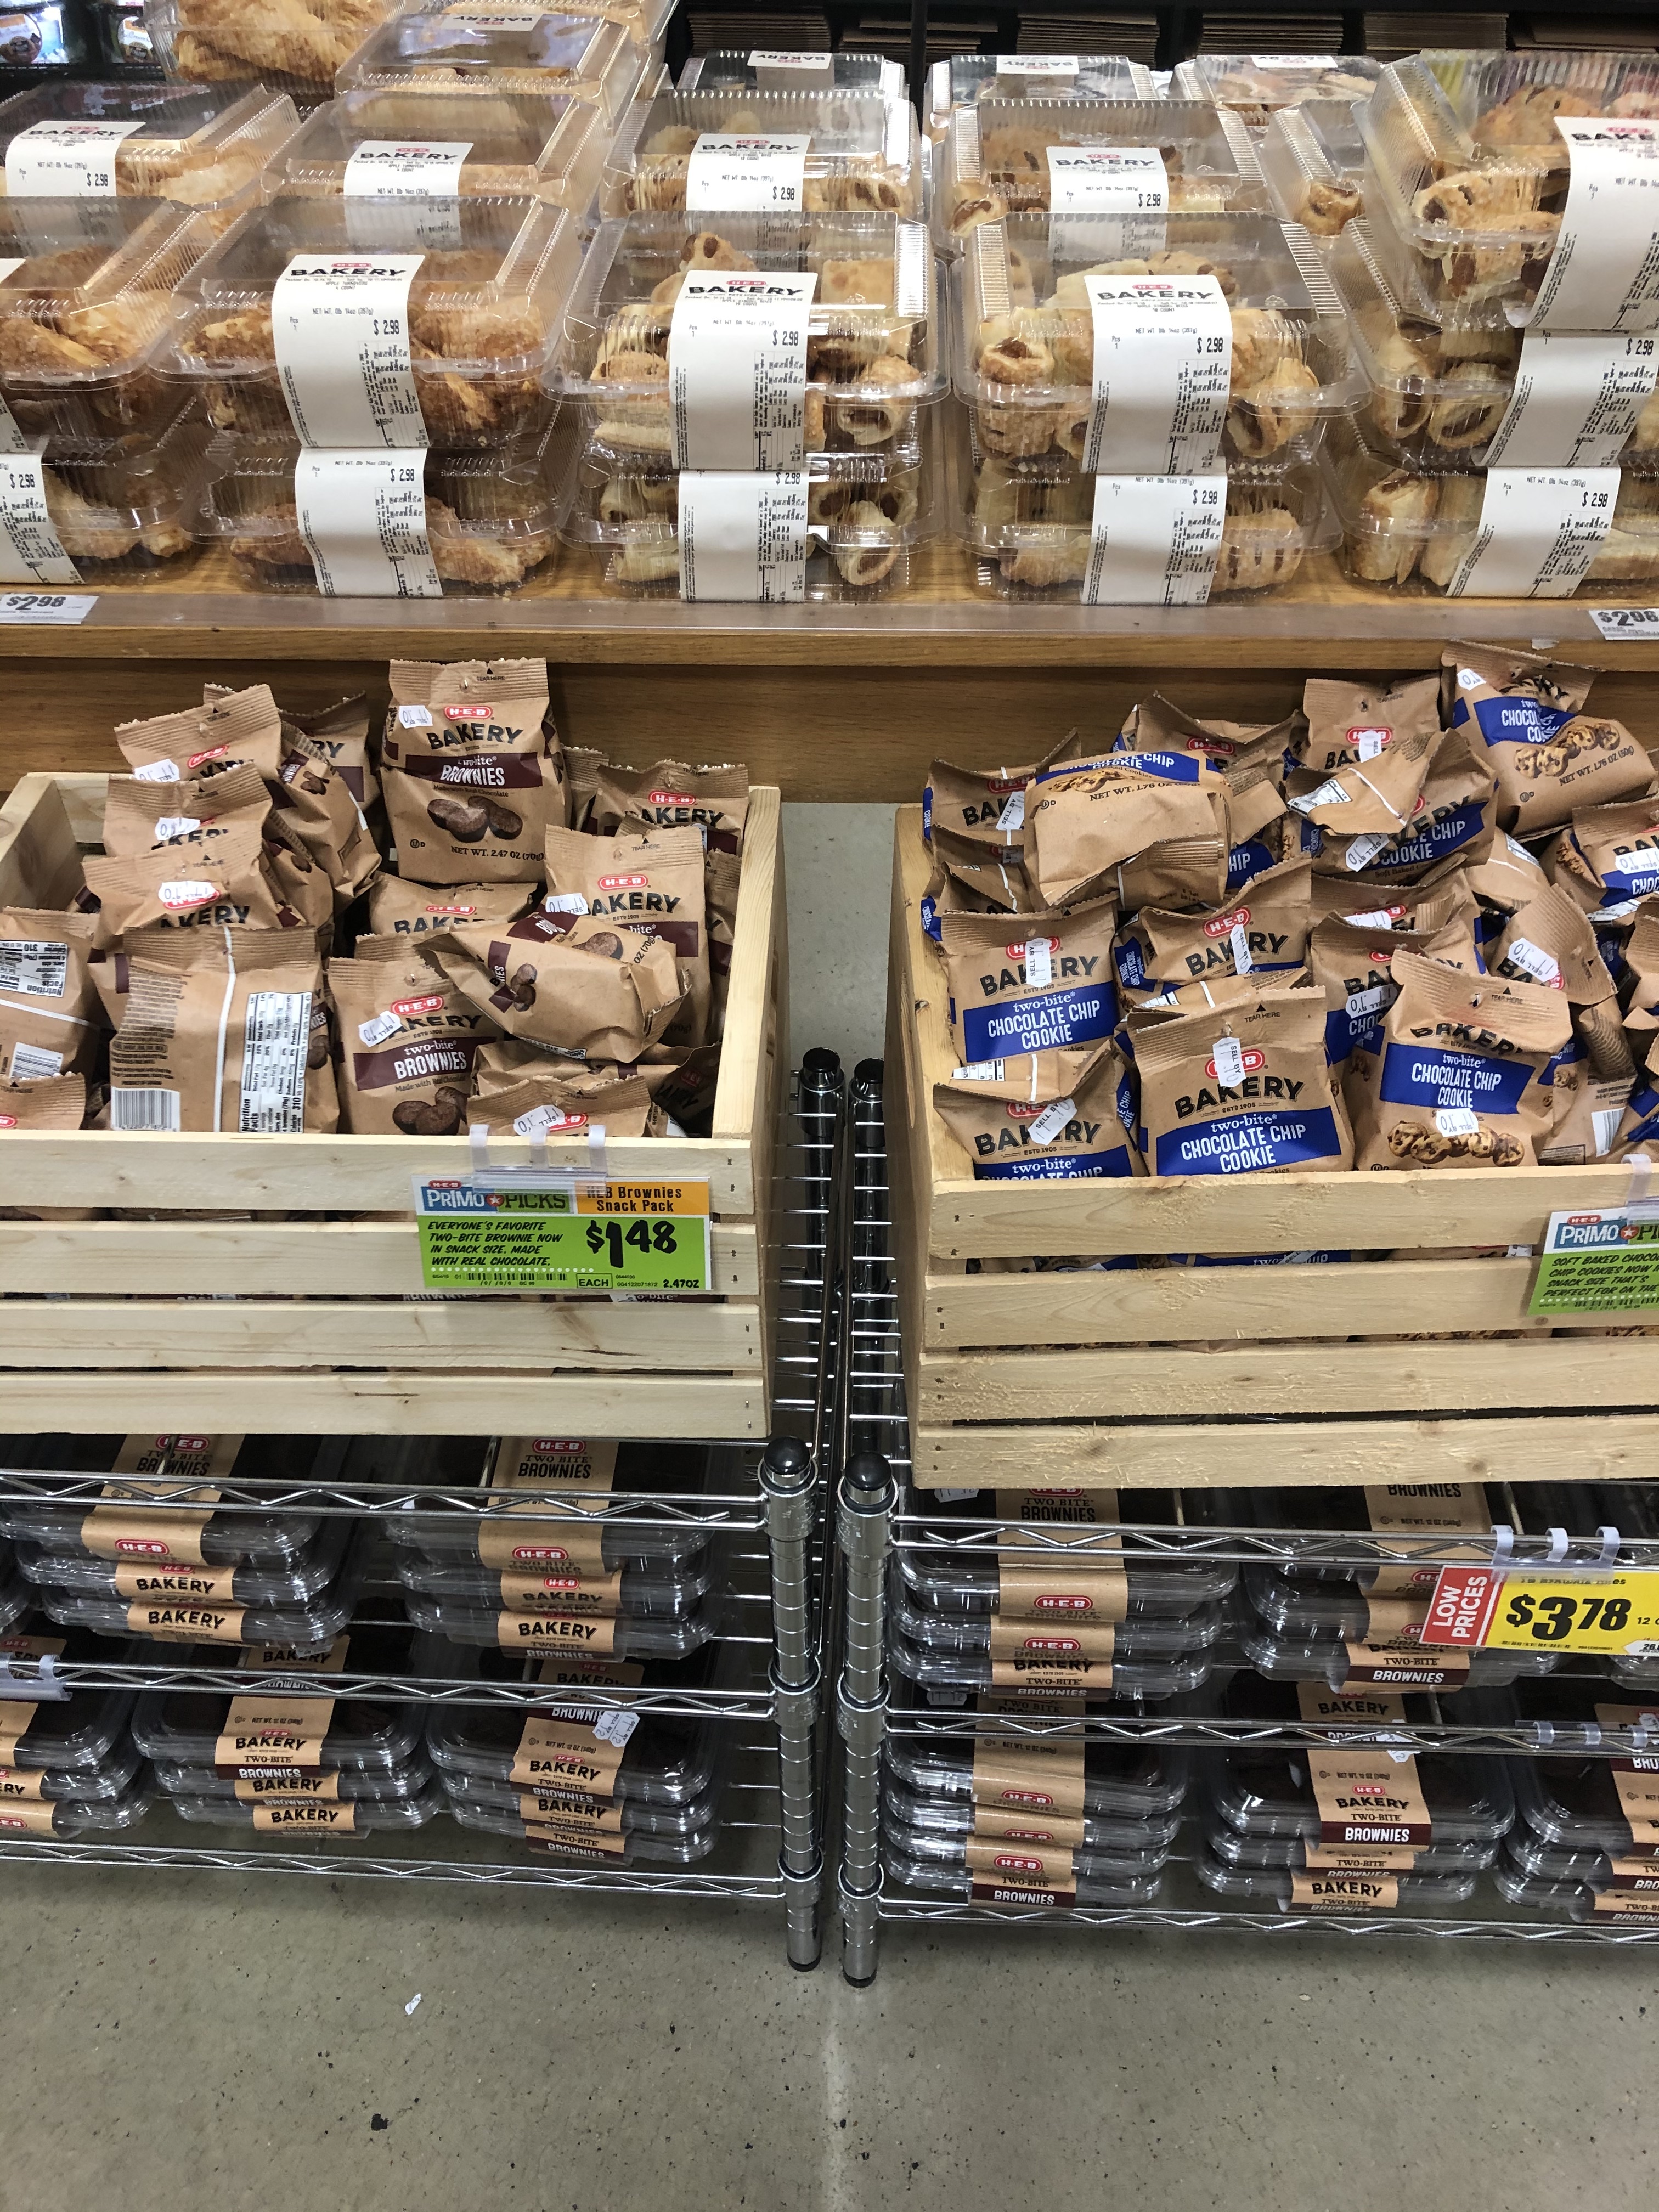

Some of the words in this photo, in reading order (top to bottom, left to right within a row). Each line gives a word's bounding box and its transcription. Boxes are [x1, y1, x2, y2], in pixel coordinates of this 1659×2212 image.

[95, 174, 109, 187] 2.98
[772, 186, 777, 200] $
[781, 187, 794, 200] 2.98
[1138, 194, 1143, 207] $
[1147, 194, 1161, 206] 2.98
[291, 268, 407, 276] BAKERY
[689, 286, 804, 296] BAKERY
[1097, 291, 1214, 300] BAKERY
[374, 319, 379, 336] $
[383, 320, 399, 335] 2.98
[772, 330, 777, 346] $
[782, 331, 799, 346] 2.98
[1197, 337, 1202, 354] $
[1207, 337, 1223, 353] 2.98
[1626, 338, 1632, 356] $
[1635, 339, 1654, 356] 2.98
[19, 473, 35, 488] 2.98
[390, 468, 395, 482] $
[399, 469, 415, 481] 2.98
[776, 472, 781, 485] $
[785, 472, 800, 484] 2.98
[1193, 489, 1198, 505] $
[1201, 490, 1218, 504] 2.98
[1582, 492, 1588, 507] $
[1591, 493, 1608, 508] 2.98
[426, 723, 523, 749] BAKERY
[1144, 753, 1175, 768] CHIP
[440, 765, 505, 786] BROWNIES
[1560, 773, 1576, 786] NET
[1090, 790, 1111, 802] NET
[1113, 785, 1135, 795] WT.
[1431, 820, 1466, 841] CHIP
[451, 845, 469, 855] NET
[471, 849, 489, 857] WT.
[491, 849, 507, 857] 2.47
[510, 850, 521, 859] OZ
[522, 851, 545, 861] (70g)
[1029, 945, 1035, 957] BY
[988, 1006, 1065, 1038] CHOCOLATE
[1068, 1000, 1100, 1022] CHIP
[1244, 1014, 1260, 1023] TEAR
[1021, 1024, 1073, 1049] COOKIE
[394, 1051, 467, 1079] BROWNIES
[1233, 1063, 1241, 1073] BY
[1412, 1063, 1472, 1088] CHOCOLATE
[1474, 1071, 1502, 1091] CHIP
[395, 1084, 414, 1092] Made
[415, 1080, 431, 1088] with
[292, 1097, 301, 1110] 310
[1175, 1075, 1305, 1120] BAKERY
[1437, 1086, 1473, 1108] COOKIE
[241, 1098, 251, 1132] Nutrition
[1035, 1114, 1051, 1129] SELL
[1049, 1103, 1059, 1112] BY
[1181, 1126, 1266, 1160] CHOCOLATE
[1270, 1124, 1306, 1142] CHIP
[1220, 1145, 1276, 1173] COOKIE
[427, 1189, 485, 1209] PRIMO
[618, 1186, 682, 1198] Brownies
[597, 1200, 637, 1211] Snack
[642, 1200, 674, 1211] Pack
[428, 1221, 493, 1231] EVERYONE'S
[495, 1221, 546, 1231] FAVORITE
[430, 1233, 483, 1242] TWO-BITE
[485, 1233, 536, 1242] BROWNIE
[537, 1234, 563, 1243] NOW
[1560, 1224, 1619, 1245] PRIMO
[430, 1245, 440, 1254] IN
[445, 1245, 481, 1254] SNACK
[482, 1245, 507, 1254] SIZE.
[511, 1245, 543, 1254] MADE
[586, 1219, 677, 1268] $148
[432, 1257, 459, 1265] WITH
[461, 1257, 486, 1266] REAL
[490, 1257, 551, 1266] CHOCOLATE.
[1551, 1256, 1581, 1267] SOFT
[1582, 1255, 1620, 1265] BAKED
[1549, 1268, 1576, 1277] CHIP
[1577, 1266, 1623, 1277] COOKIES
[1624, 1264, 1653, 1273] NOW
[579, 1279, 609, 1287] EACH
[663, 1279, 699, 1288] 2.47OZ
[1547, 1278, 1584, 1288] SNACK
[1584, 1277, 1610, 1286] SIZE
[1611, 1275, 1649, 1284] THAT'S
[1543, 1288, 1594, 1297] PERFECT
[1594, 1286, 1618, 1295] FOR
[518, 1463, 591, 1479] BROWNIES
[1387, 1484, 1462, 1498] BROWNIES
[1059, 1498, 1090, 1506] BITE
[1021, 1506, 1095, 1522] BROWNIES
[136, 1577, 215, 1594] BAKERY
[522, 1592, 603, 1603] BAKERY
[1432, 1585, 1462, 1627] LOW
[1451, 1576, 1488, 1638] PRICES
[148, 1610, 226, 1629] BAKERY
[1506, 1594, 1632, 1640] $378
[1637, 1617, 1650, 1625] 12
[518, 1621, 597, 1640] BAKERY
[1384, 1657, 1440, 1666] TWO-BITE
[1373, 1670, 1444, 1683] BROWNIES
[1018, 1688, 1087, 1697] BROWNIES
[1318, 1701, 1389, 1716] BAKERY
[235, 1737, 306, 1751] BAKERY
[239, 1768, 301, 1778] BROWNIES
[529, 1760, 601, 1781] BAKERY
[252, 1778, 323, 1792] BAKERY
[533, 1787, 594, 1803] BROWNIES
[538, 1799, 606, 1819] BAKERY
[1335, 1796, 1409, 1810] BAKERY
[271, 1809, 338, 1823] BAKERY
[1351, 1813, 1402, 1821] TWO-BITE
[1345, 1827, 1410, 1842] BROWNIES
[548, 1843, 605, 1859] BROWNIES
[994, 1889, 1055, 1905] BROWNIES
[1311, 1881, 1383, 1898] BAKERY
